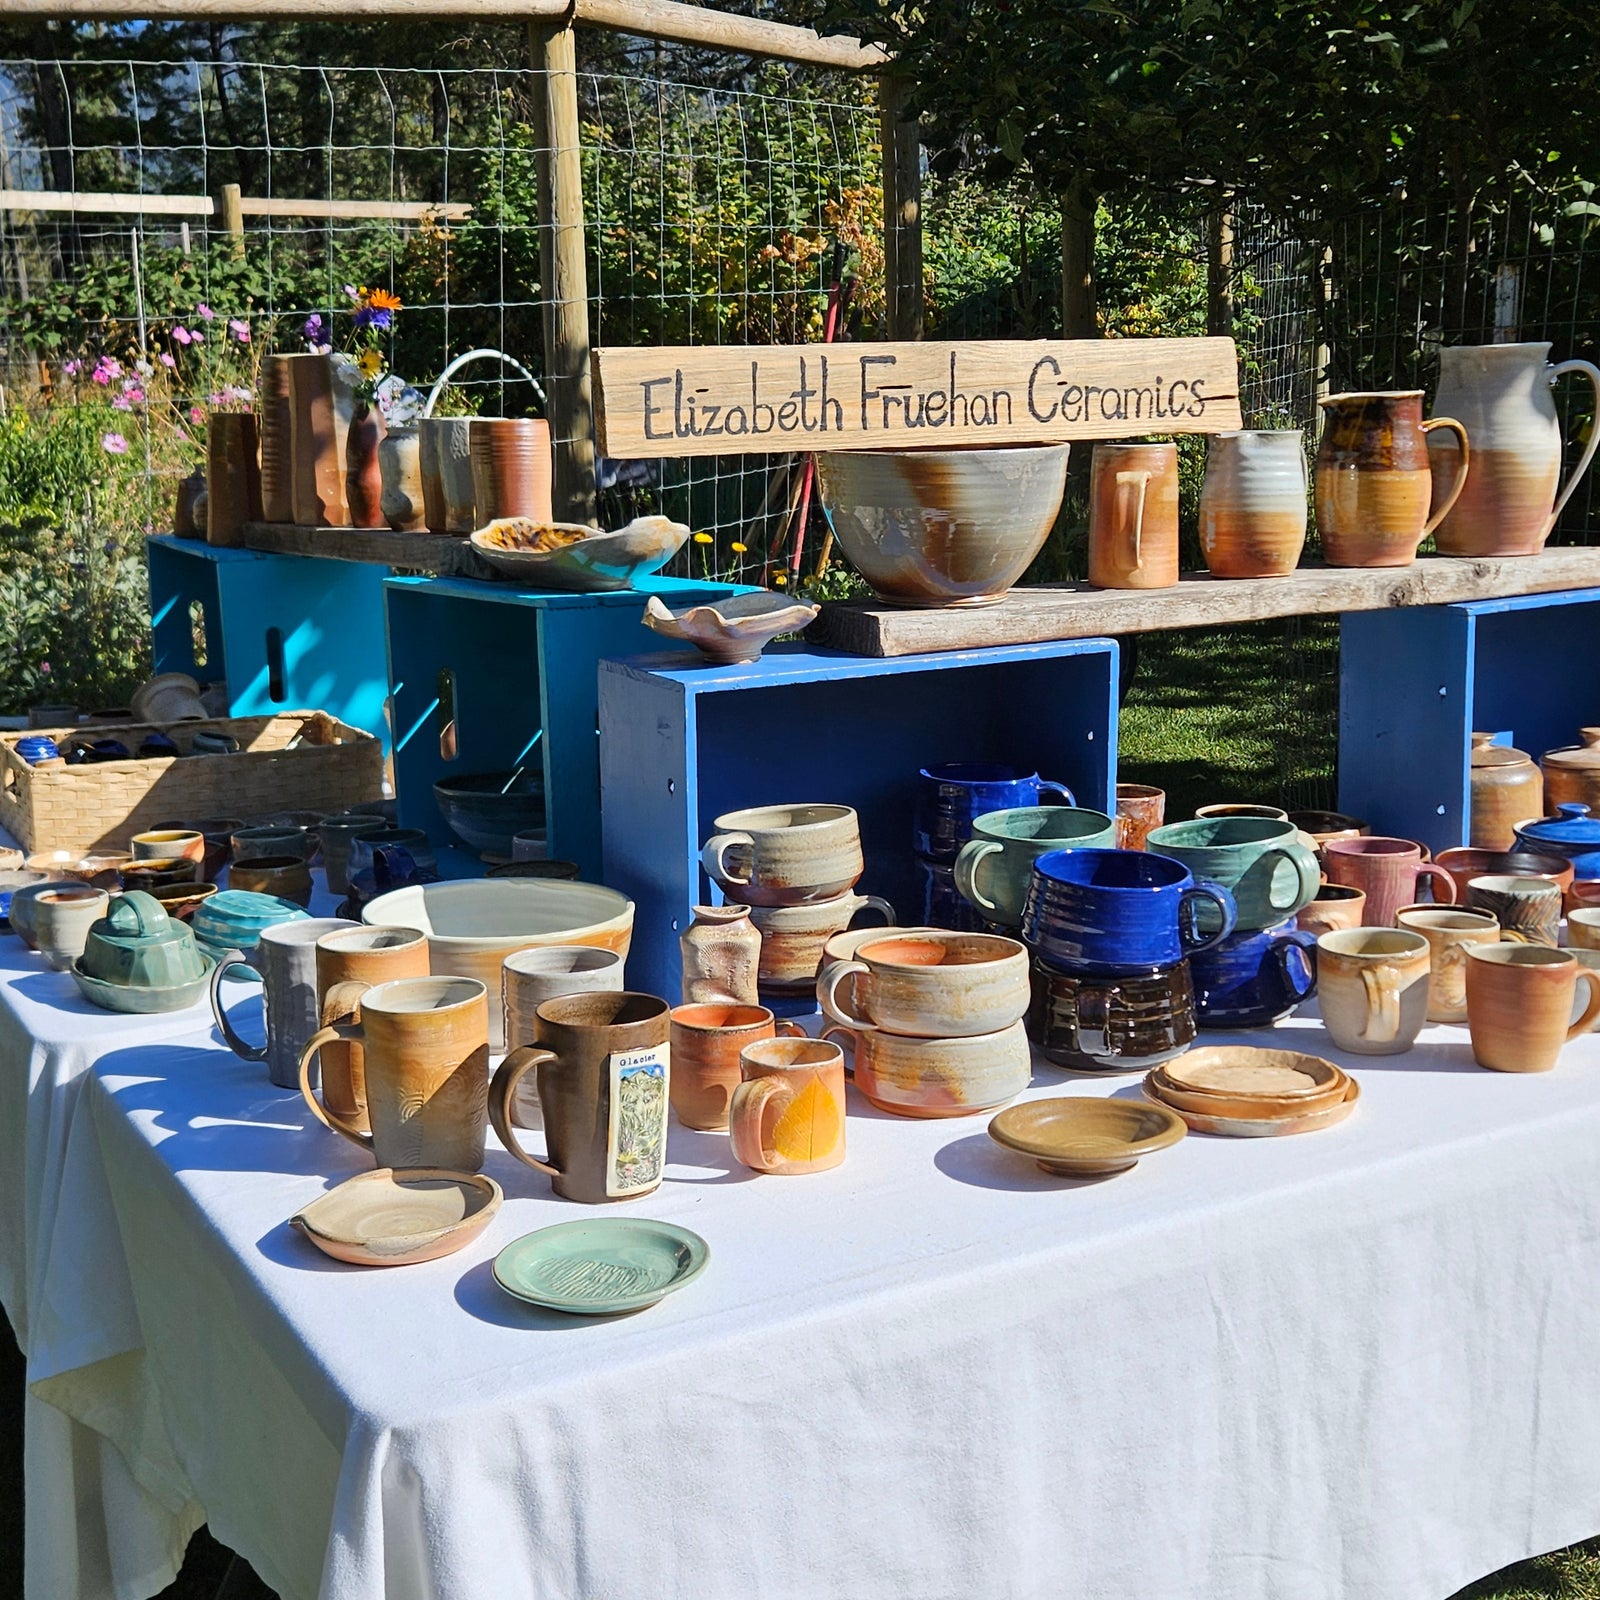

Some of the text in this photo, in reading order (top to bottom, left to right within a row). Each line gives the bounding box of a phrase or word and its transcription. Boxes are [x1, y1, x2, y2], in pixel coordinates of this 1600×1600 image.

[640, 351, 1206, 440] Elizabeth Fruehan Ceramics
[619, 1053, 656, 1066] Glacier
